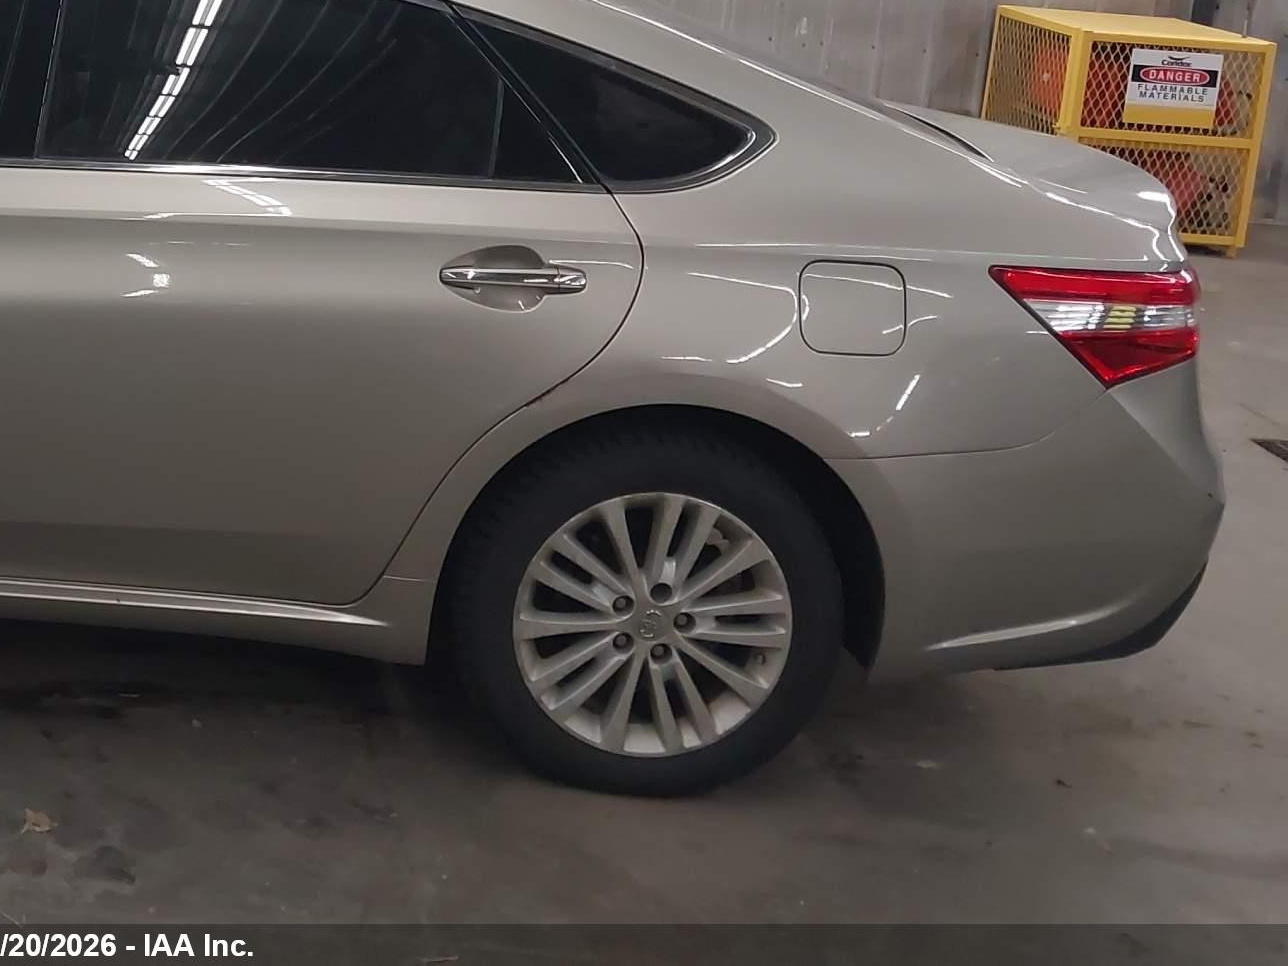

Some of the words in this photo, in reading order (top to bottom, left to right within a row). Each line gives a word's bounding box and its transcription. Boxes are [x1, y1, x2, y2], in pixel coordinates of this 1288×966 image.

[1148, 69, 1201, 83] DANGER
[1137, 83, 1209, 96] FLAMMABLE
[1138, 91, 1204, 103] MATERIALS
